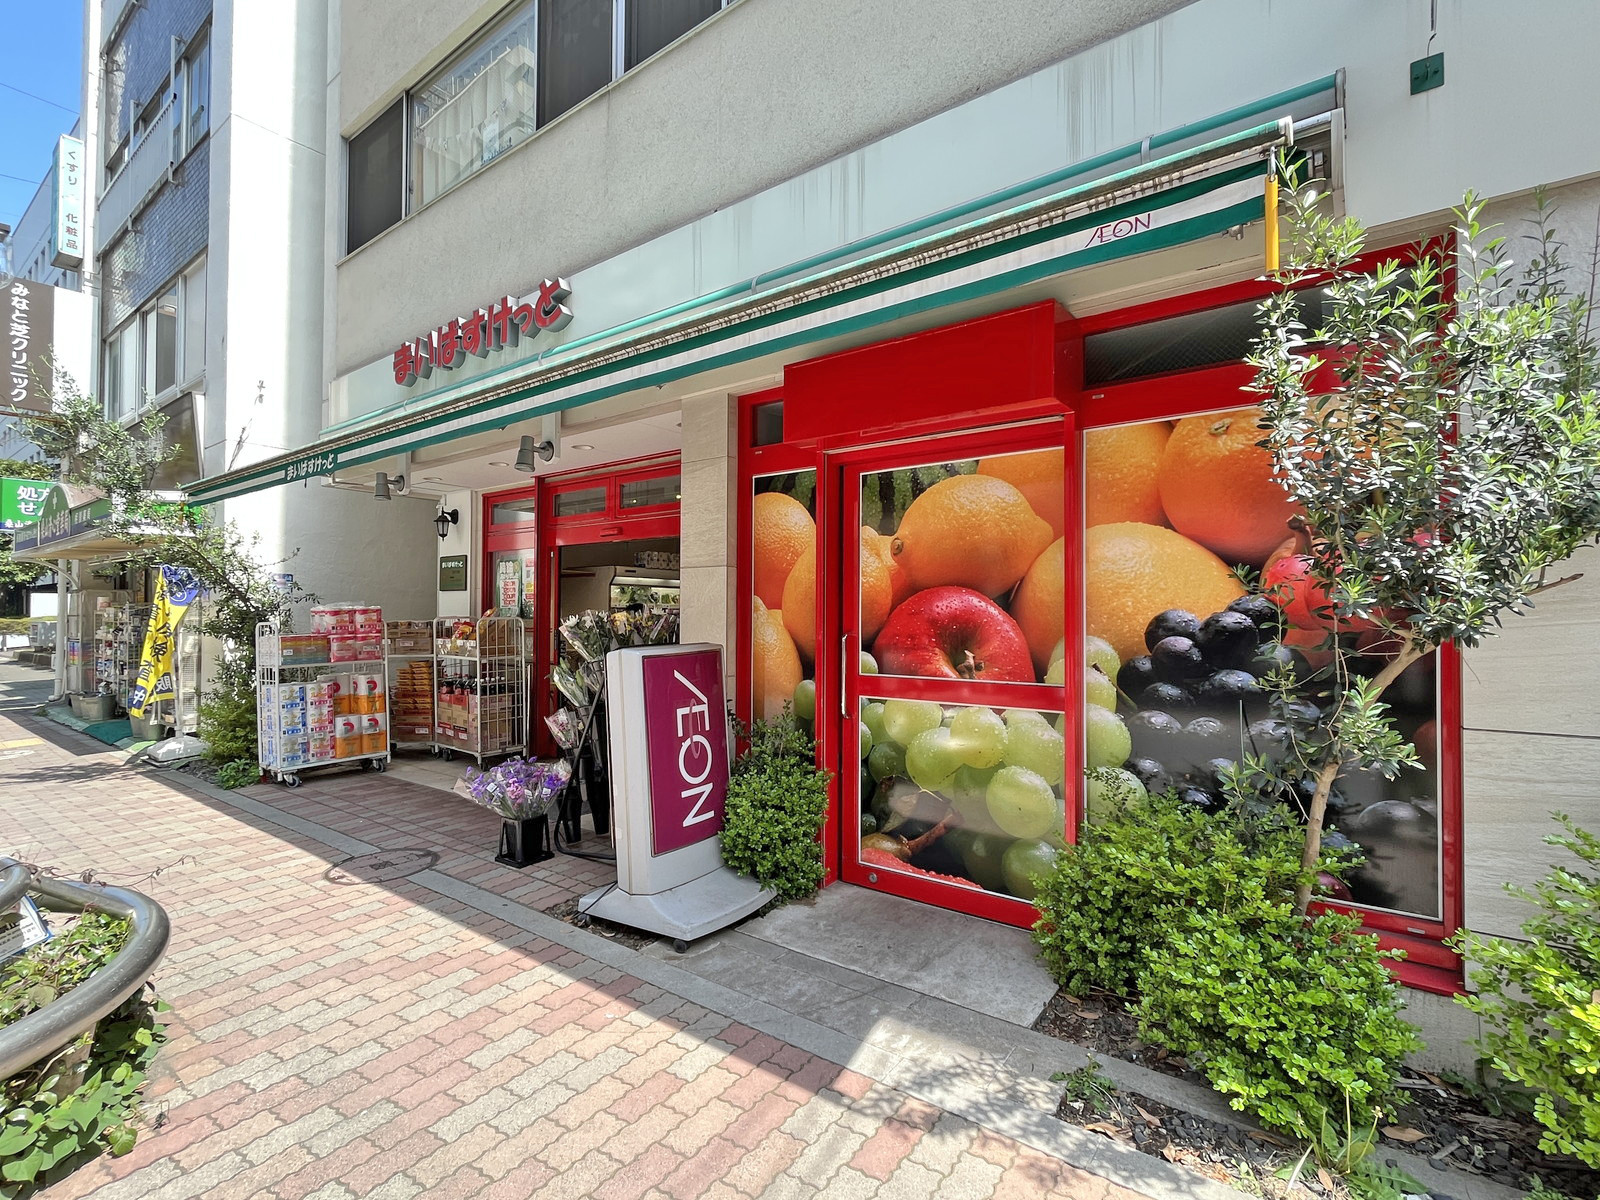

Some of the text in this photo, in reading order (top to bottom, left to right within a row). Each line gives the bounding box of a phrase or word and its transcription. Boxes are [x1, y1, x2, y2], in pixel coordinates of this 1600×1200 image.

[65, 150, 79, 250] くすり 化粧品
[10, 282, 31, 402] みなと芝クリニック
[393, 277, 573, 387] まいばすけっと
[287, 452, 335, 481] まいばすけっと
